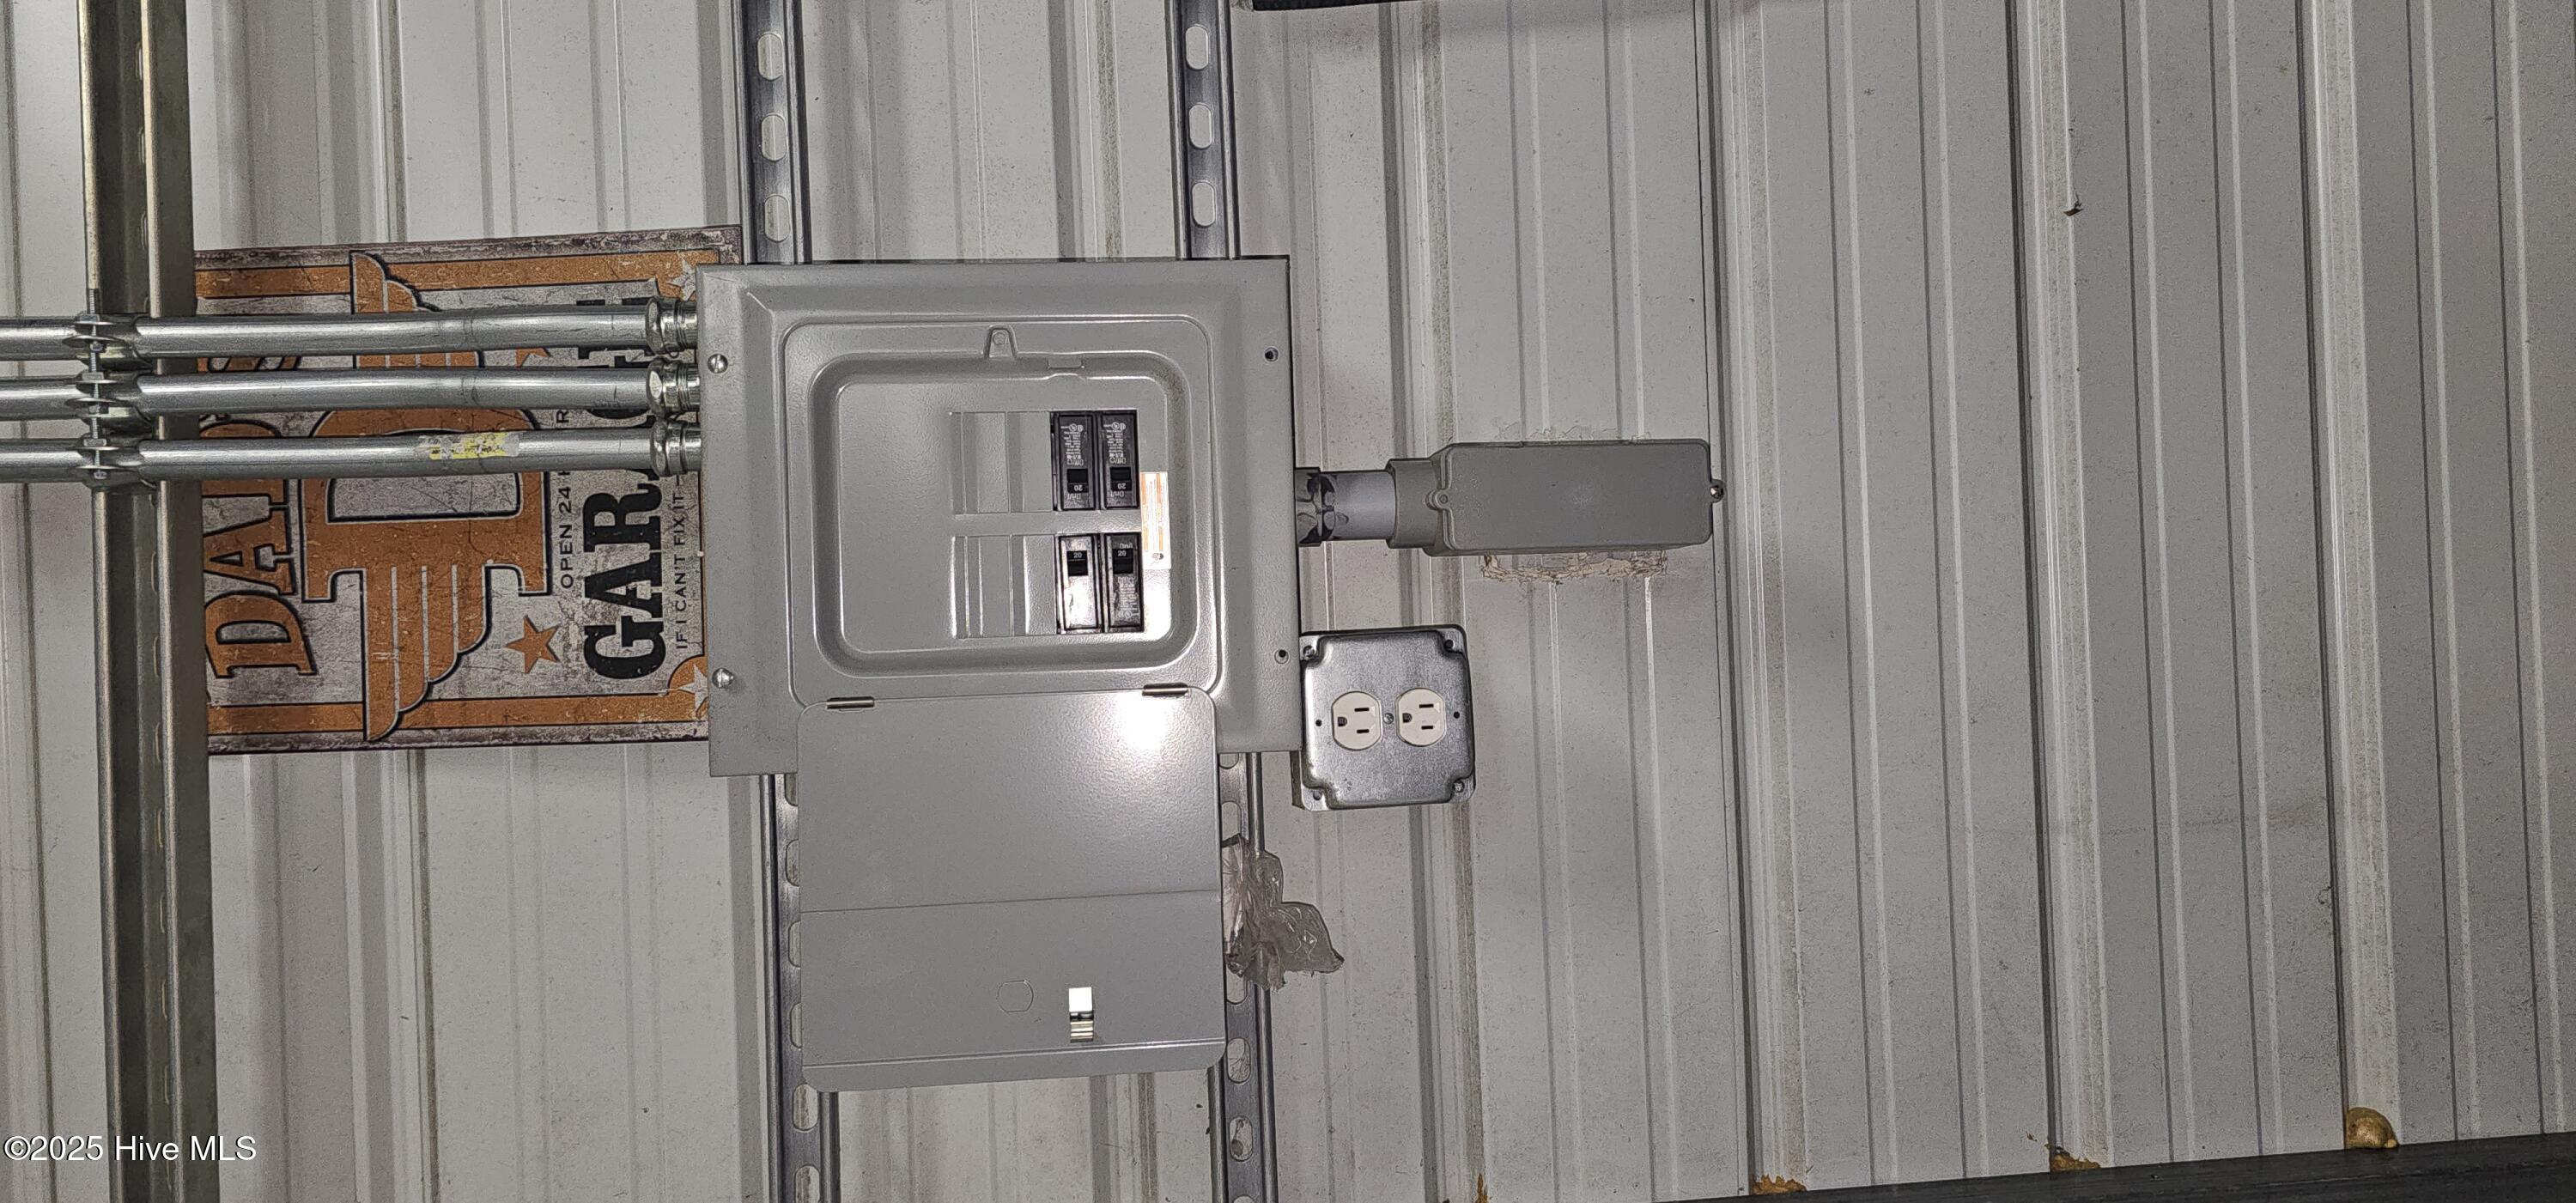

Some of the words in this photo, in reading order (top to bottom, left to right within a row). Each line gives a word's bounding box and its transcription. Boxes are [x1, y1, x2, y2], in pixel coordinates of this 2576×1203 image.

[559, 486, 572, 514] 24
[672, 494, 684, 513] IT
[672, 515, 686, 546] FIX
[559, 524, 574, 589] OPEN
[673, 555, 687, 612] CAN'T
[676, 631, 688, 648] IF
